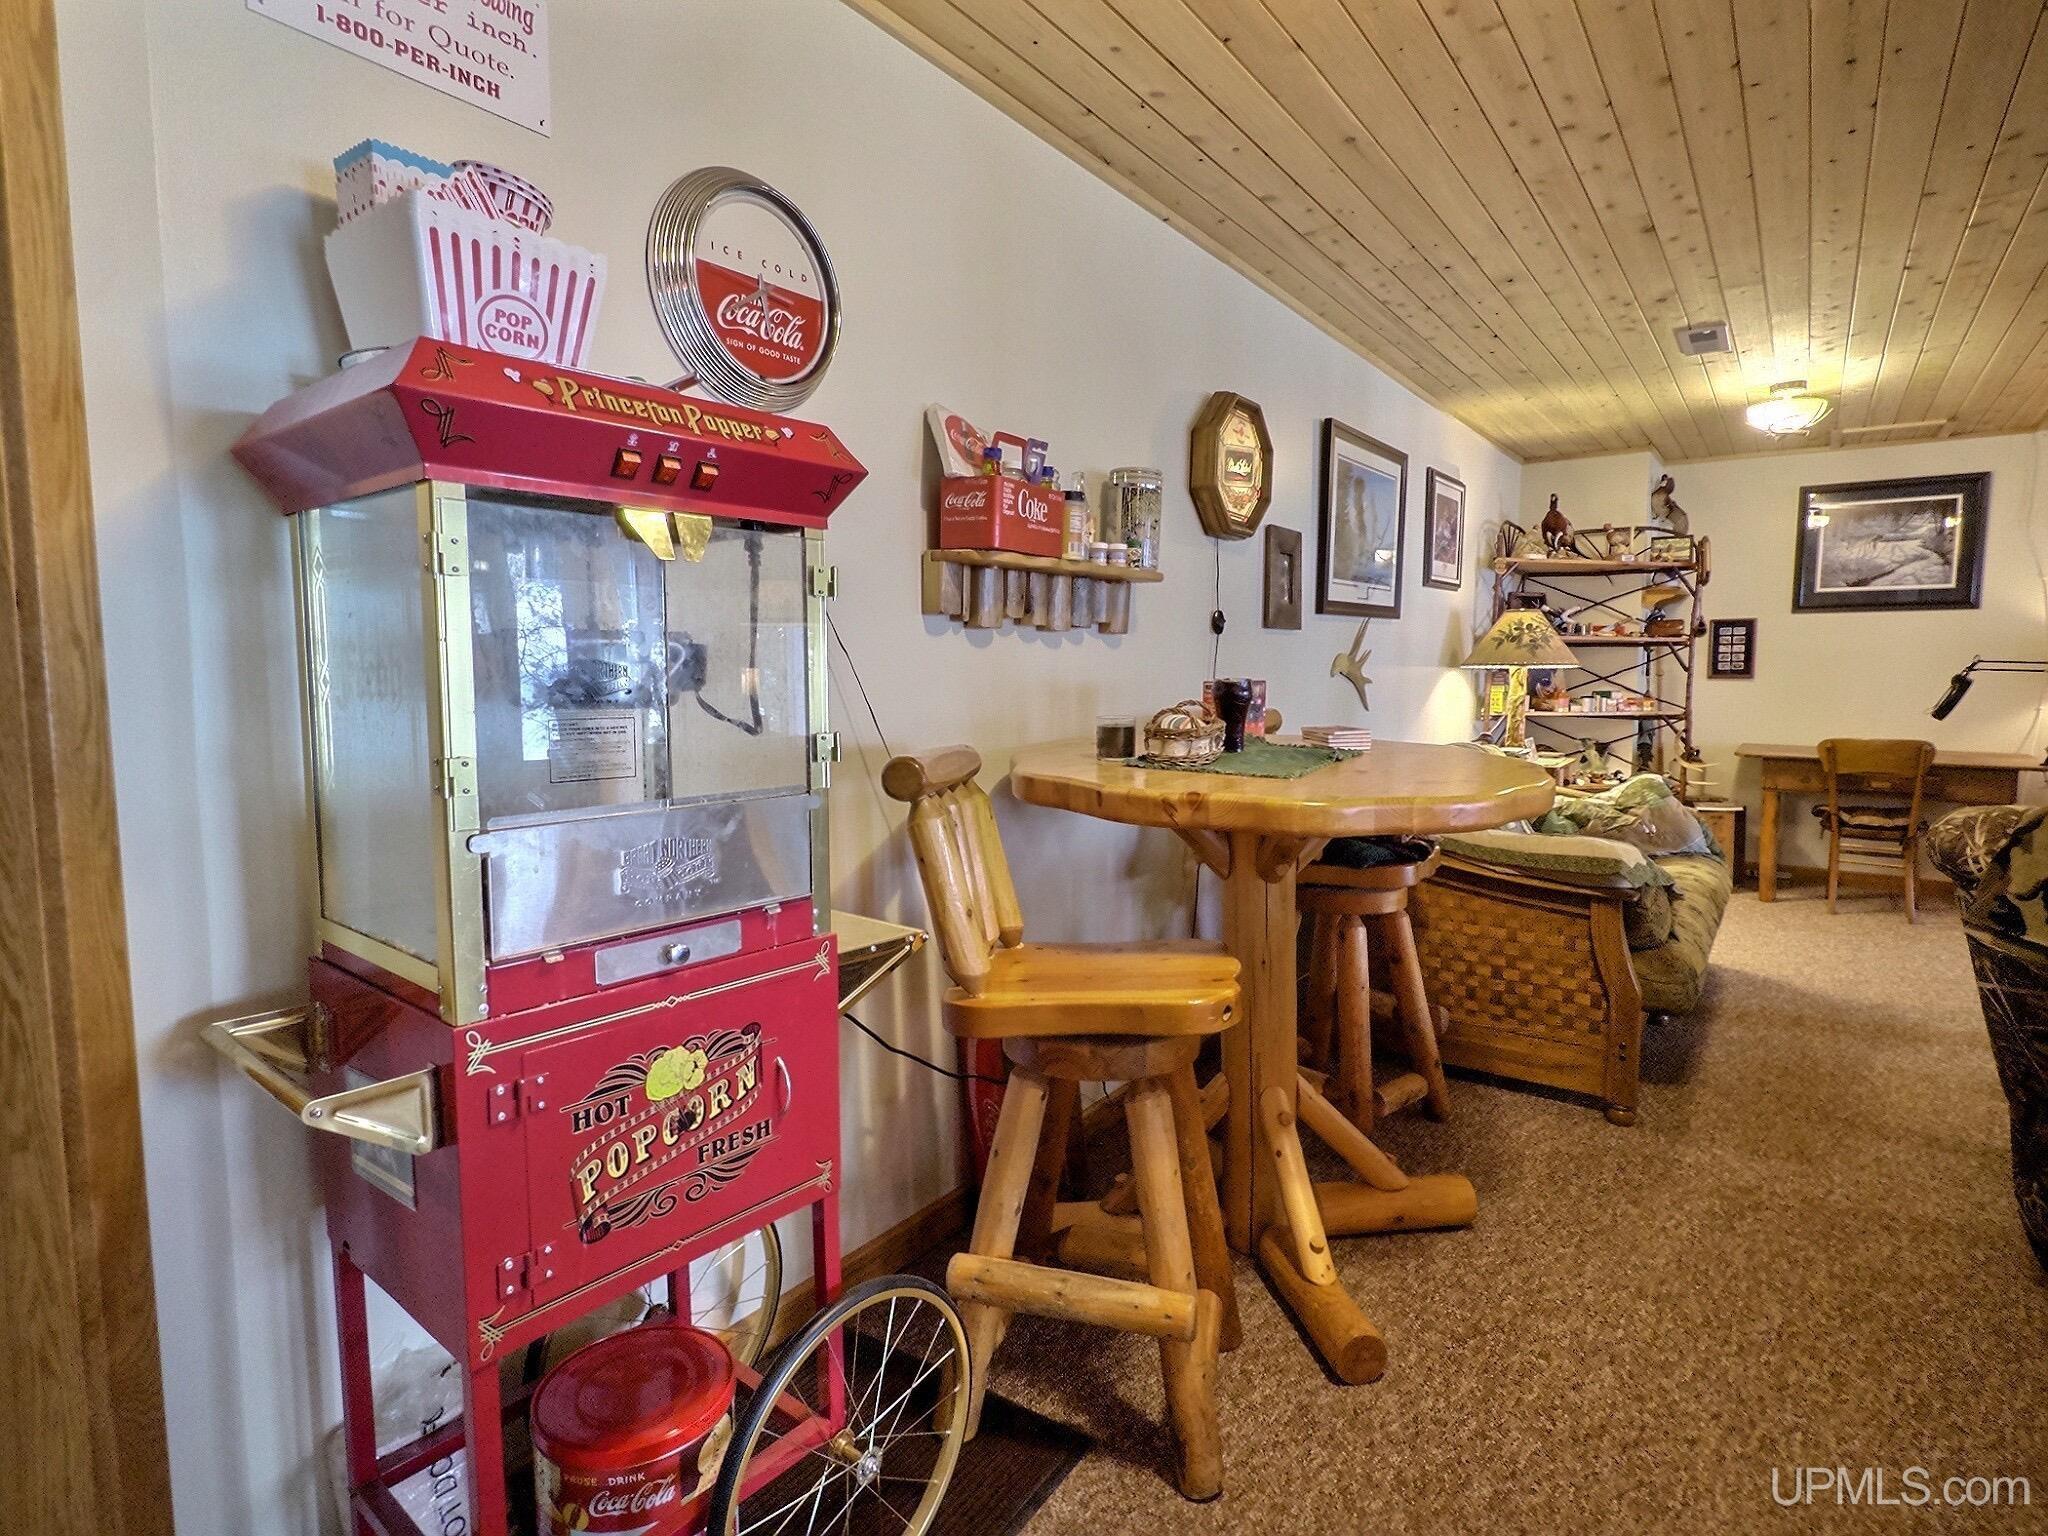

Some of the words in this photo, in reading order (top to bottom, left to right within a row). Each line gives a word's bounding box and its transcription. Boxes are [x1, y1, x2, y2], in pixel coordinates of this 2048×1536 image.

[316, 4, 501, 100] 1-800-PER-INCH
[375, 0, 415, 32] for
[429, 25, 515, 80] Quote.
[467, 11, 537, 58] inch.
[711, 241, 742, 260] ICE
[761, 259, 808, 283] COLD
[485, 323, 539, 349] CORN
[495, 308, 532, 330] POP
[717, 294, 807, 350] Coca-Cola
[726, 337, 744, 348] SIGN
[746, 343, 756, 351] OF
[759, 346, 781, 359] GOOD
[783, 353, 800, 365] TASTE
[556, 377, 685, 426] Princeton
[681, 403, 765, 442] Popper
[1018, 489, 1048, 522] Coke
[570, 1095, 632, 1135] HOT
[576, 1056, 758, 1205] POPCORN
[697, 1119, 773, 1164] FRESH
[588, 1473, 679, 1518] Coca-Cola
[608, 1472, 646, 1487] DRINK
